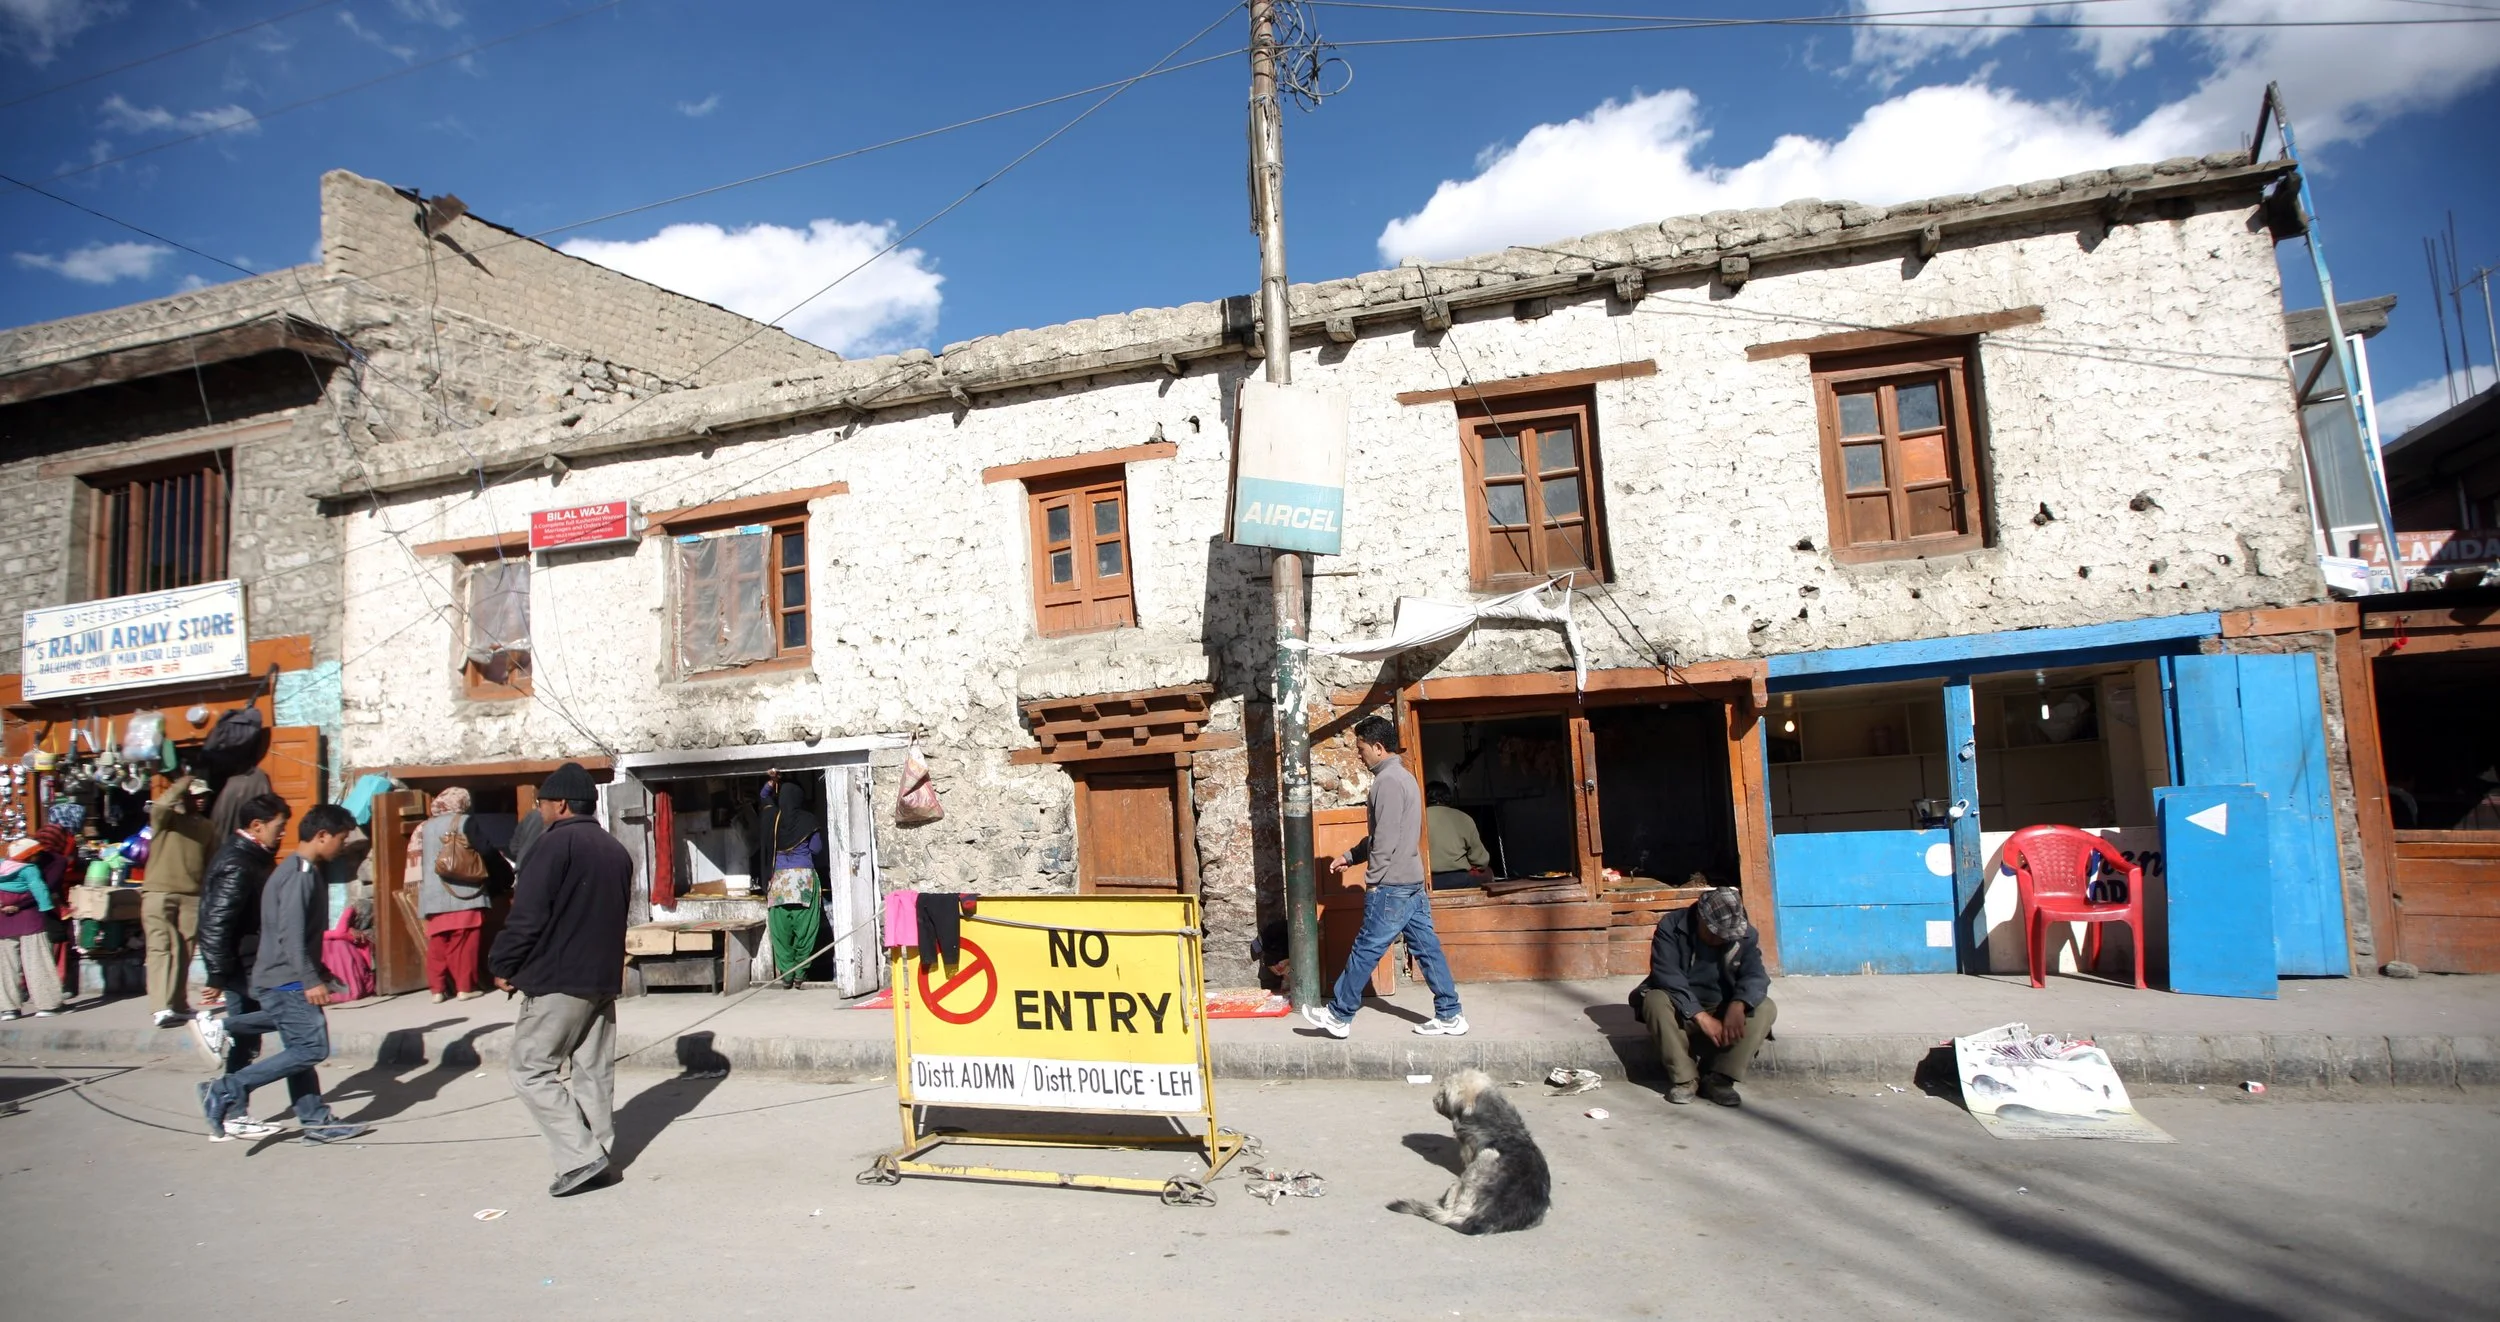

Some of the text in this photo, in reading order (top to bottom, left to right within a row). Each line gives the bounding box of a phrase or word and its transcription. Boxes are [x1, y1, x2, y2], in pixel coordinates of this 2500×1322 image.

[547, 505, 609, 521] BILAL WAZA
[1241, 501, 1338, 532] AIRCEL
[48, 631, 104, 658] RAJNI
[111, 621, 172, 649] ARMY
[179, 612, 234, 640] STORE
[1047, 928, 1110, 968] NO
[1014, 990, 1172, 1034] ENTRY
[1158, 1071, 1193, 1097] LEH
